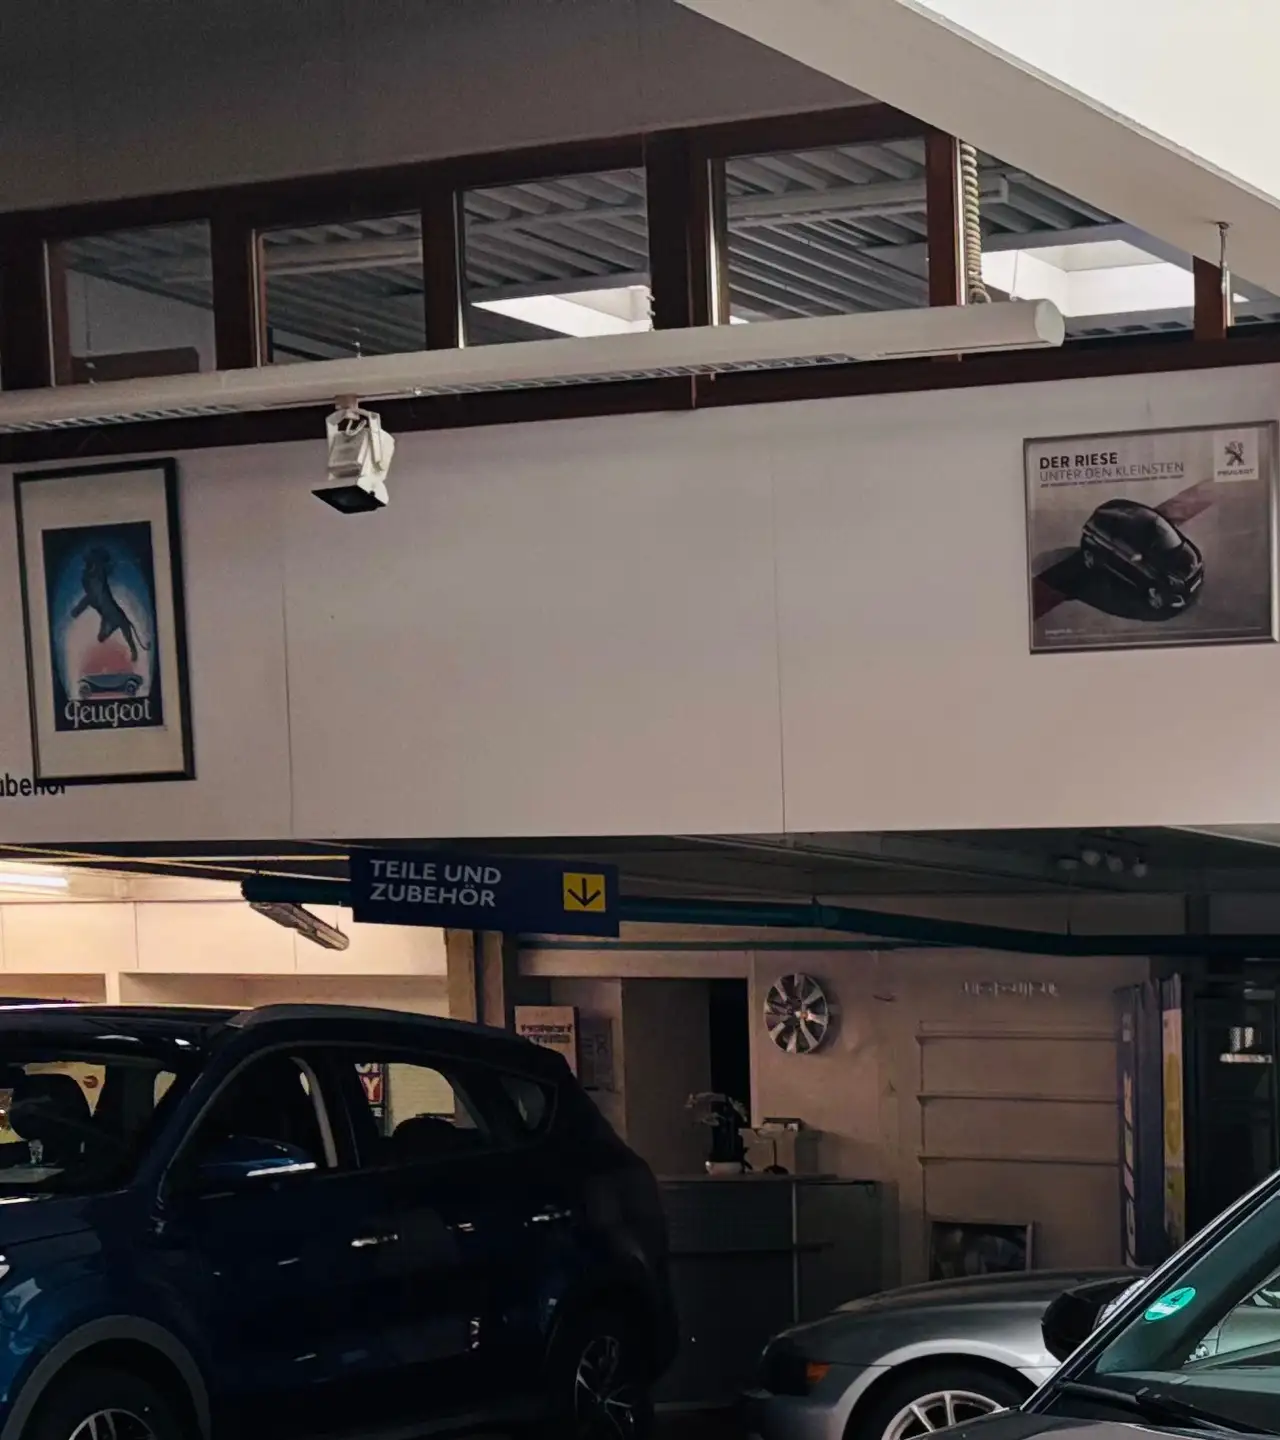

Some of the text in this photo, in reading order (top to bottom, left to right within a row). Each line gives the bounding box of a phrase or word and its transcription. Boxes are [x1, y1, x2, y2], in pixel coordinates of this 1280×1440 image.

[1039, 452, 1118, 469] DER RIESE
[1040, 470, 1081, 482] UNTER
[1085, 467, 1113, 479] DEN
[1116, 462, 1184, 477] KLEINSTEN
[370, 860, 502, 884] TEILE UND
[369, 882, 496, 908] ZUBEHÖR
